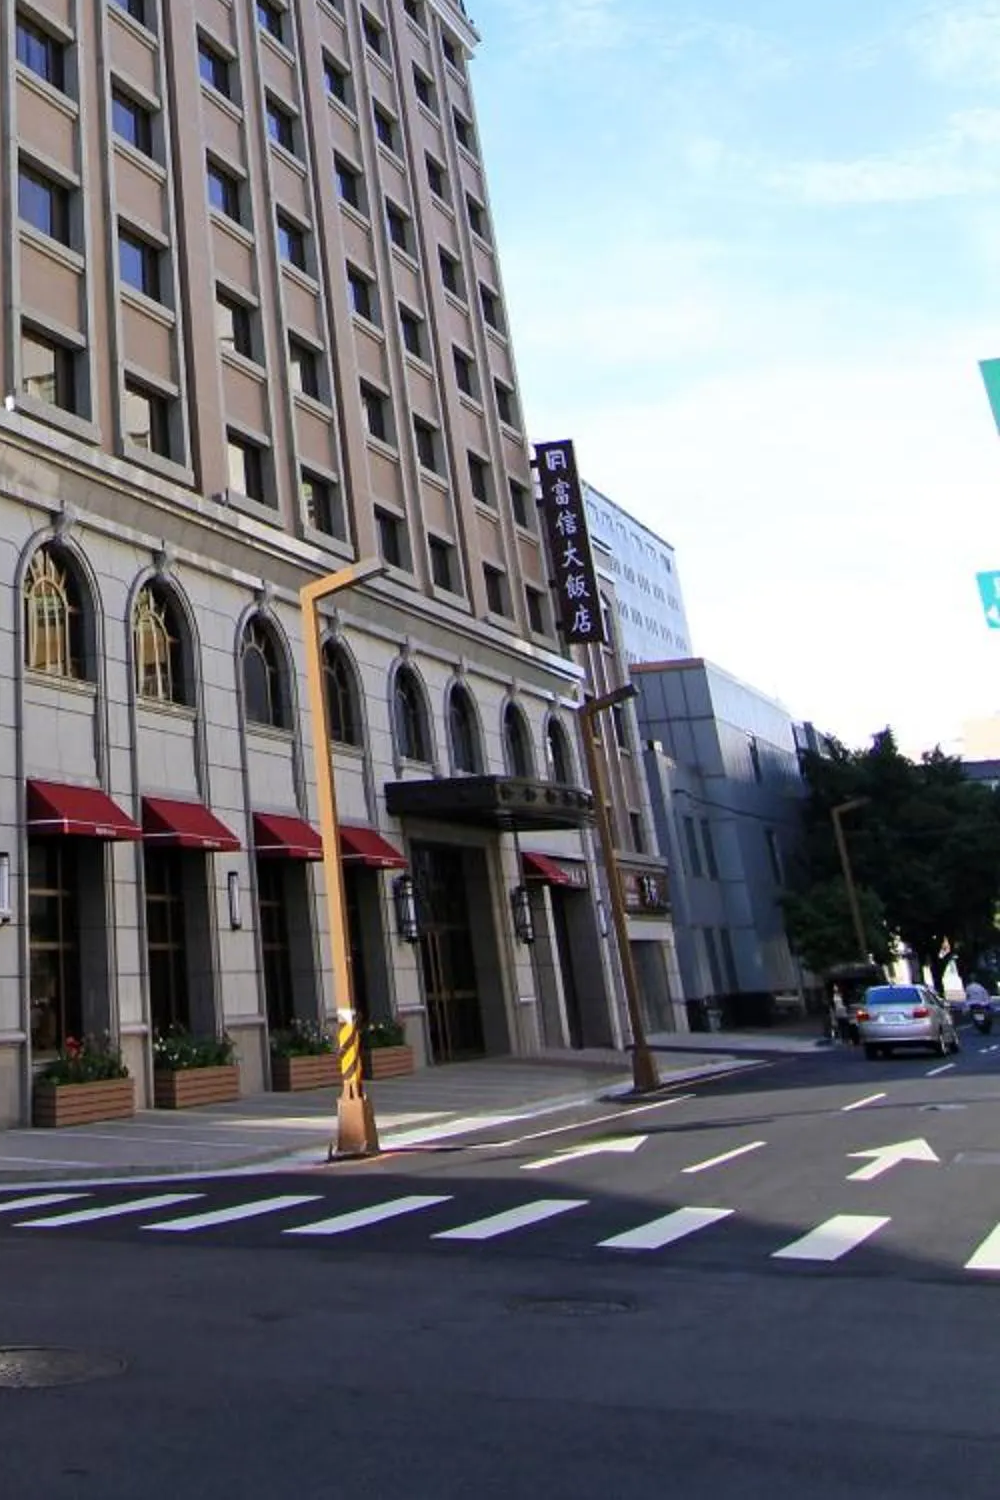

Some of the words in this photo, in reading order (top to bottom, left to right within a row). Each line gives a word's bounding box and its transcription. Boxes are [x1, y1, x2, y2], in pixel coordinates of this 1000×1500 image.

[551, 478, 592, 634] 富信大飯店
